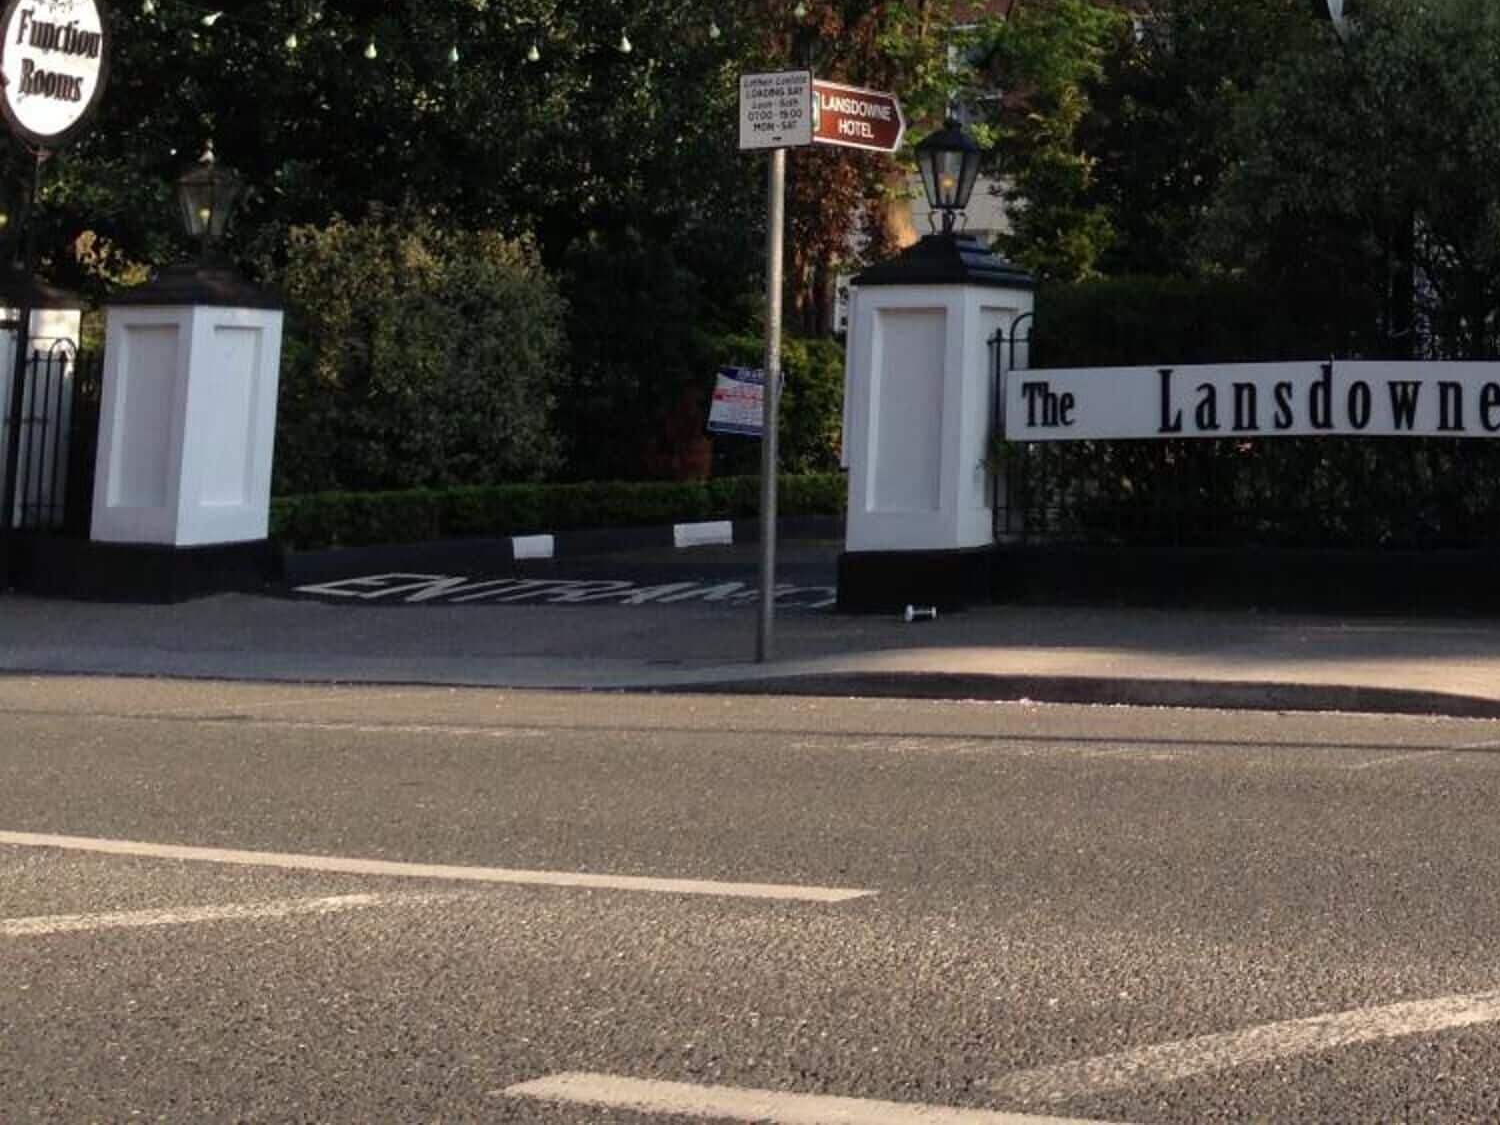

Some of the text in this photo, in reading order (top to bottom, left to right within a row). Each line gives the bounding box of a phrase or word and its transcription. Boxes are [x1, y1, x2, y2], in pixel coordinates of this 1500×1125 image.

[16, 8, 101, 59] Function
[18, 58, 84, 103] Rooms
[821, 94, 891, 121] LANSDOWNE
[838, 118, 875, 139] HOTEL
[1021, 380, 1075, 428] The
